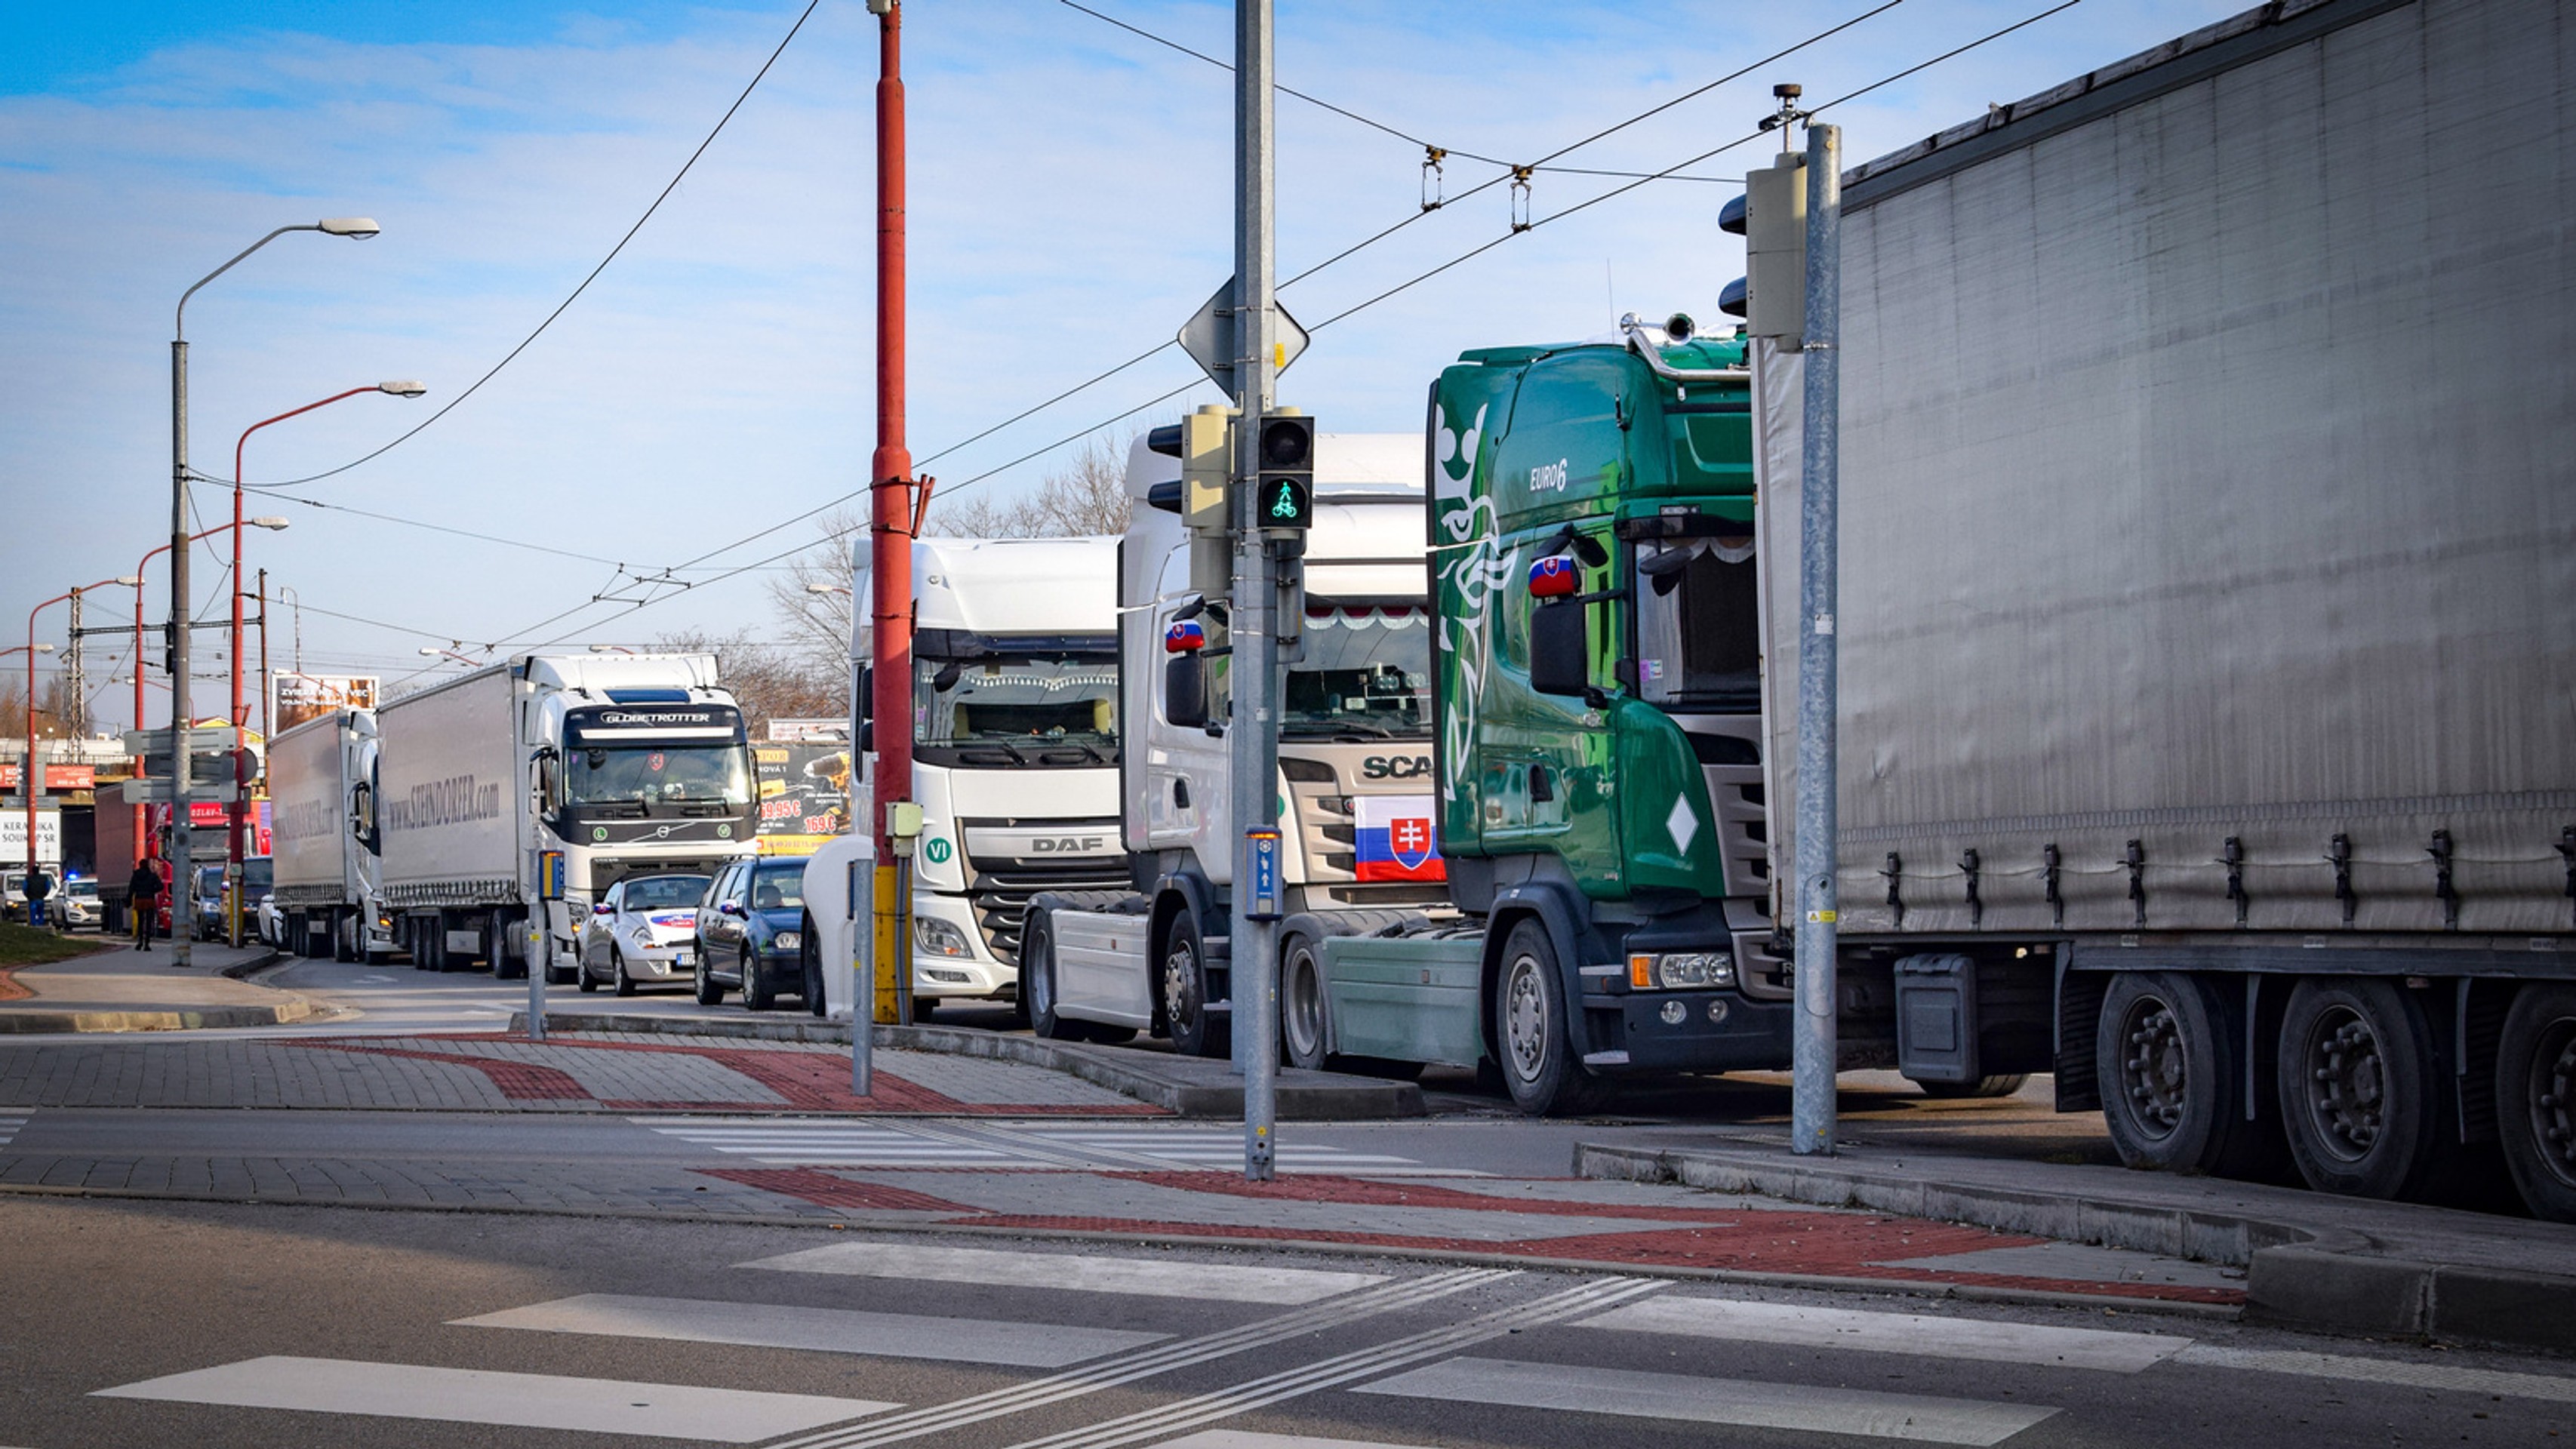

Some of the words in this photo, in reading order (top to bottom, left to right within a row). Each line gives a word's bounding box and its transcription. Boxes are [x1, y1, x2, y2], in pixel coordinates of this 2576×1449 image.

[605, 713, 710, 724] GLOBETROTTER
[4, 821, 54, 831] KERAIKA
[805, 816, 826, 833] 169
[931, 844, 947, 859] VI
[1033, 838, 1103, 852] DAF
